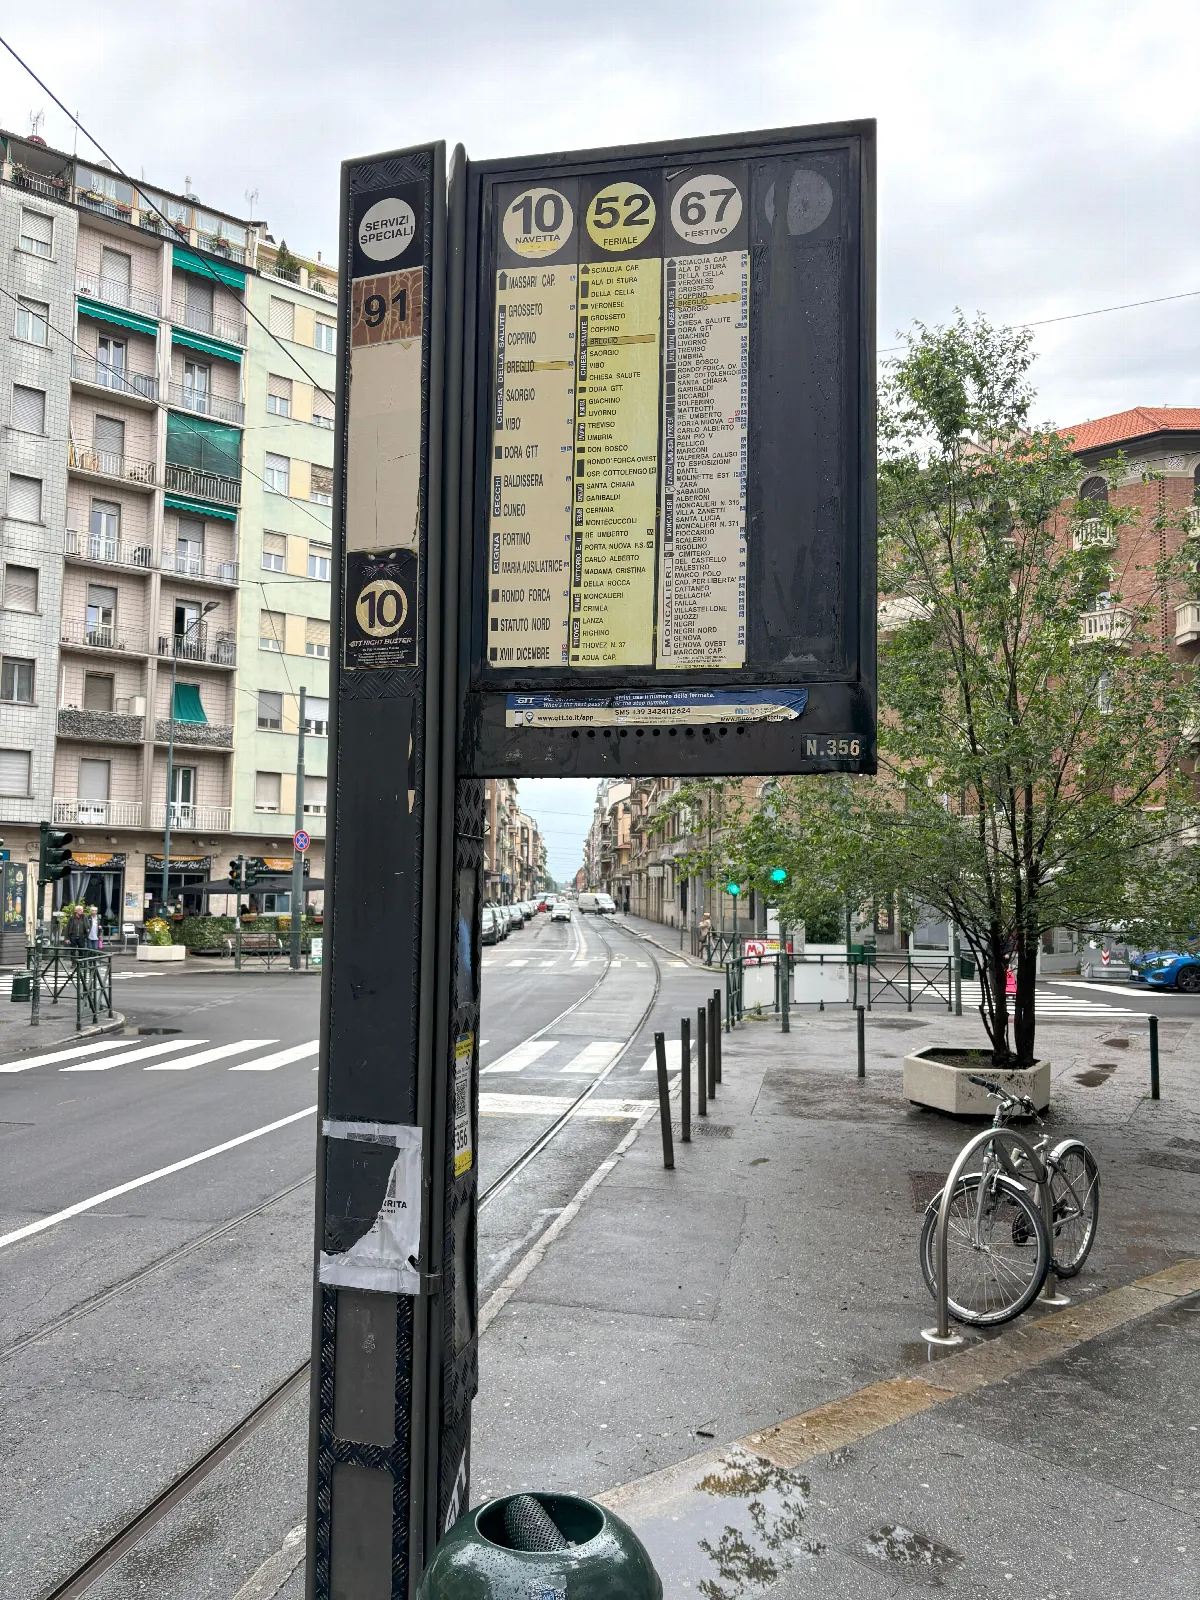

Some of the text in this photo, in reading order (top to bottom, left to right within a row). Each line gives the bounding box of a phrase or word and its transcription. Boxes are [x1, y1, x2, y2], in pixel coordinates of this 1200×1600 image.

[593, 193, 650, 229] 52
[680, 188, 736, 226] 67
[512, 194, 564, 234] 10
[366, 215, 409, 232] SERVIZI
[361, 226, 414, 245] SPECIALI
[685, 227, 728, 238] FESTIVO
[516, 235, 560, 245] NAVETTA
[603, 236, 638, 246] FERIALE
[678, 258, 710, 266] SCIALOJA
[592, 266, 622, 274] SCIALOJA
[542, 274, 556, 287] CAP.
[678, 285, 714, 293] GROSSETO
[678, 292, 708, 300] COPPINO
[365, 289, 407, 328] 91
[509, 303, 543, 317] GROSSETO
[591, 313, 625, 321] GROSSETO
[508, 332, 537, 345] COPPINO
[678, 332, 709, 340] GIACHINO
[678, 339, 707, 347] LIVORNO
[507, 360, 535, 373] BREGLIO
[506, 388, 535, 401] SAORGIO
[678, 385, 713, 393] GARIBALDI
[678, 392, 708, 400] SICCARDI
[505, 445, 538, 458] DORA GTT
[689, 459, 730, 467] ESPOSIZIONI
[603, 468, 648, 476] COTTOLENGO
[504, 474, 544, 487] BALDISSERA
[586, 494, 620, 502] GARIBALDI
[504, 504, 526, 516] CUNEO
[586, 518, 637, 526] MONTECUCCOLI
[676, 522, 716, 530] MONCALIERI
[503, 532, 530, 546] FORTINO
[502, 560, 562, 573] MARIA AUSILIATRICE
[529, 589, 550, 601] FORCA
[361, 590, 403, 628] 10
[501, 618, 550, 631] STATUTO NORD
[500, 647, 550, 660] XVIII DICEMBRE
[807, 739, 860, 756] N.356
[456, 1128, 468, 1151] 356
